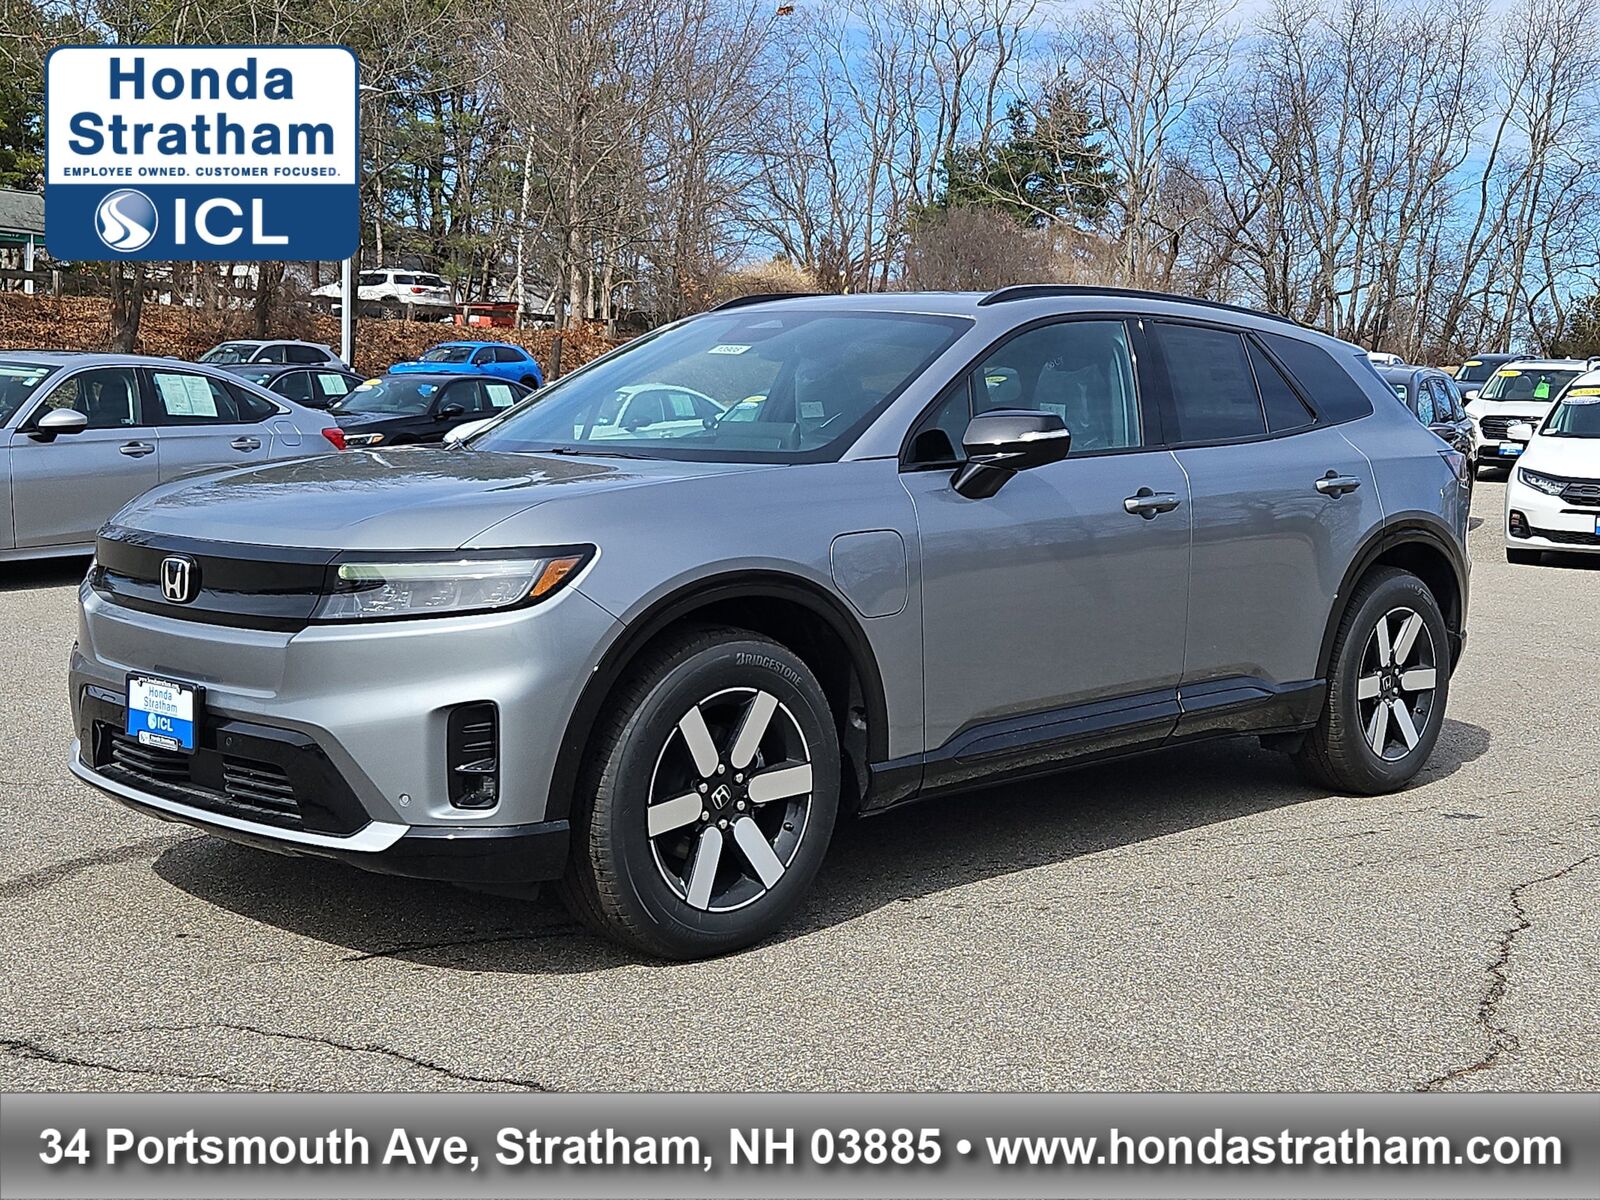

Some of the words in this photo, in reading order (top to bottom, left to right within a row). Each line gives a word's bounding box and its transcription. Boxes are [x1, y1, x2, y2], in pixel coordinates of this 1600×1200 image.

[735, 652, 803, 686] BRIDGESTONE
[148, 686, 173, 701] Honda
[143, 696, 178, 713] Stratham
[157, 716, 174, 732] ICL
